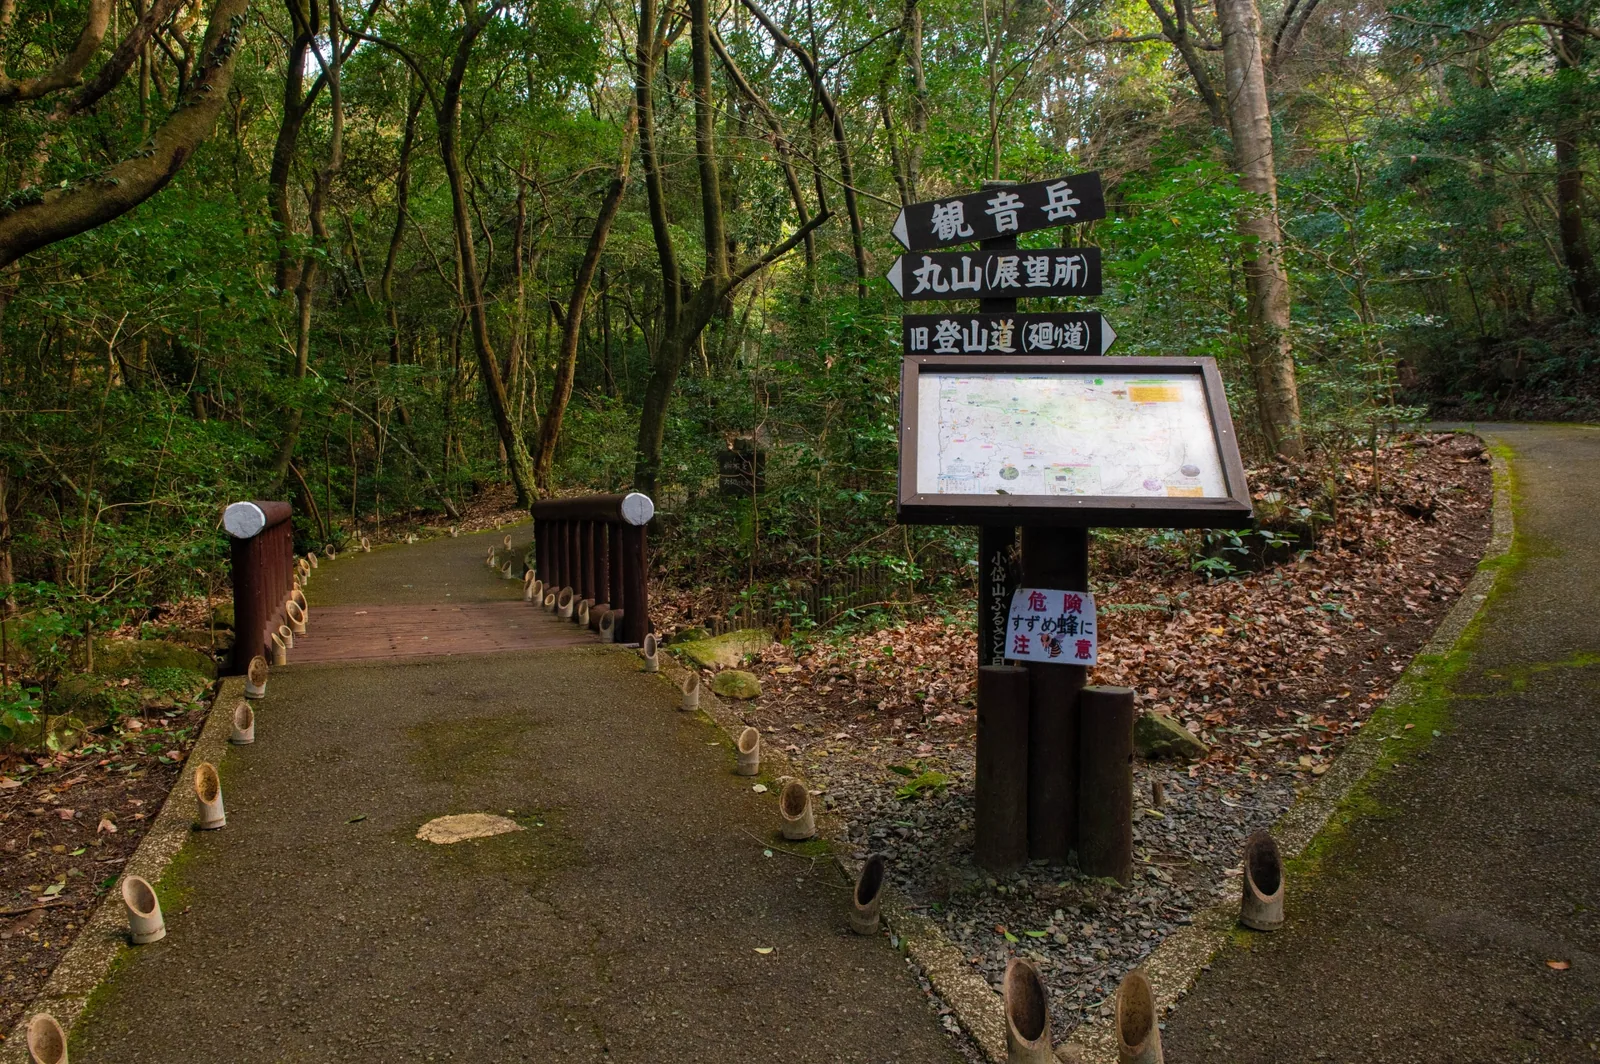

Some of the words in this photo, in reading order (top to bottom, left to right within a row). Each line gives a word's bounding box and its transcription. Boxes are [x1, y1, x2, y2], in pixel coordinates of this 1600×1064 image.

[931, 180, 1081, 241] 観音岳
[911, 253, 1088, 295] 丸山(展望所)
[1027, 590, 1083, 614] 危険
[1011, 613, 1093, 637] すずめ蜂に
